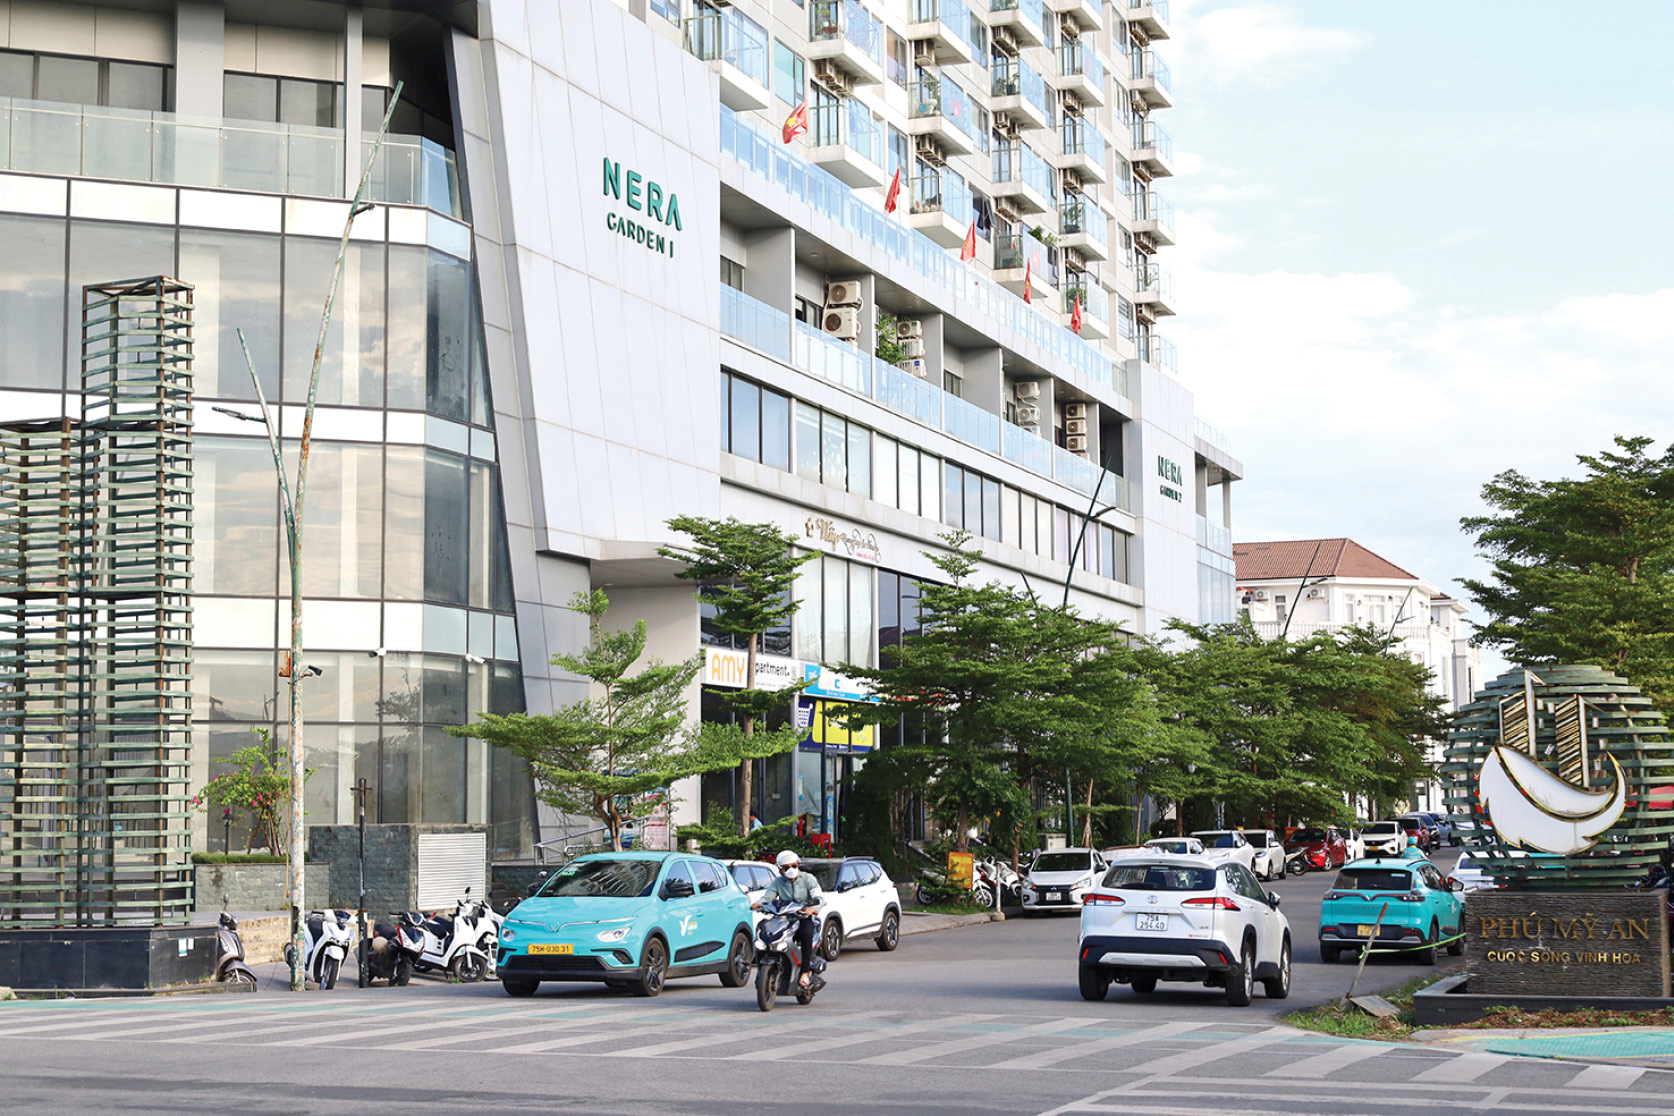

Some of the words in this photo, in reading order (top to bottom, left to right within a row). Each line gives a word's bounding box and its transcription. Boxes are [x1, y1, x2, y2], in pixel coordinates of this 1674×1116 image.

[603, 157, 682, 231] NERA
[607, 212, 665, 254] GARDEN
[1158, 455, 1182, 486] NERA
[712, 653, 745, 684] AMY
[755, 662, 790, 677] partment.
[1479, 911, 1542, 939] PHÚ
[1551, 912, 1600, 940] MỸ
[1607, 917, 1650, 940] AN
